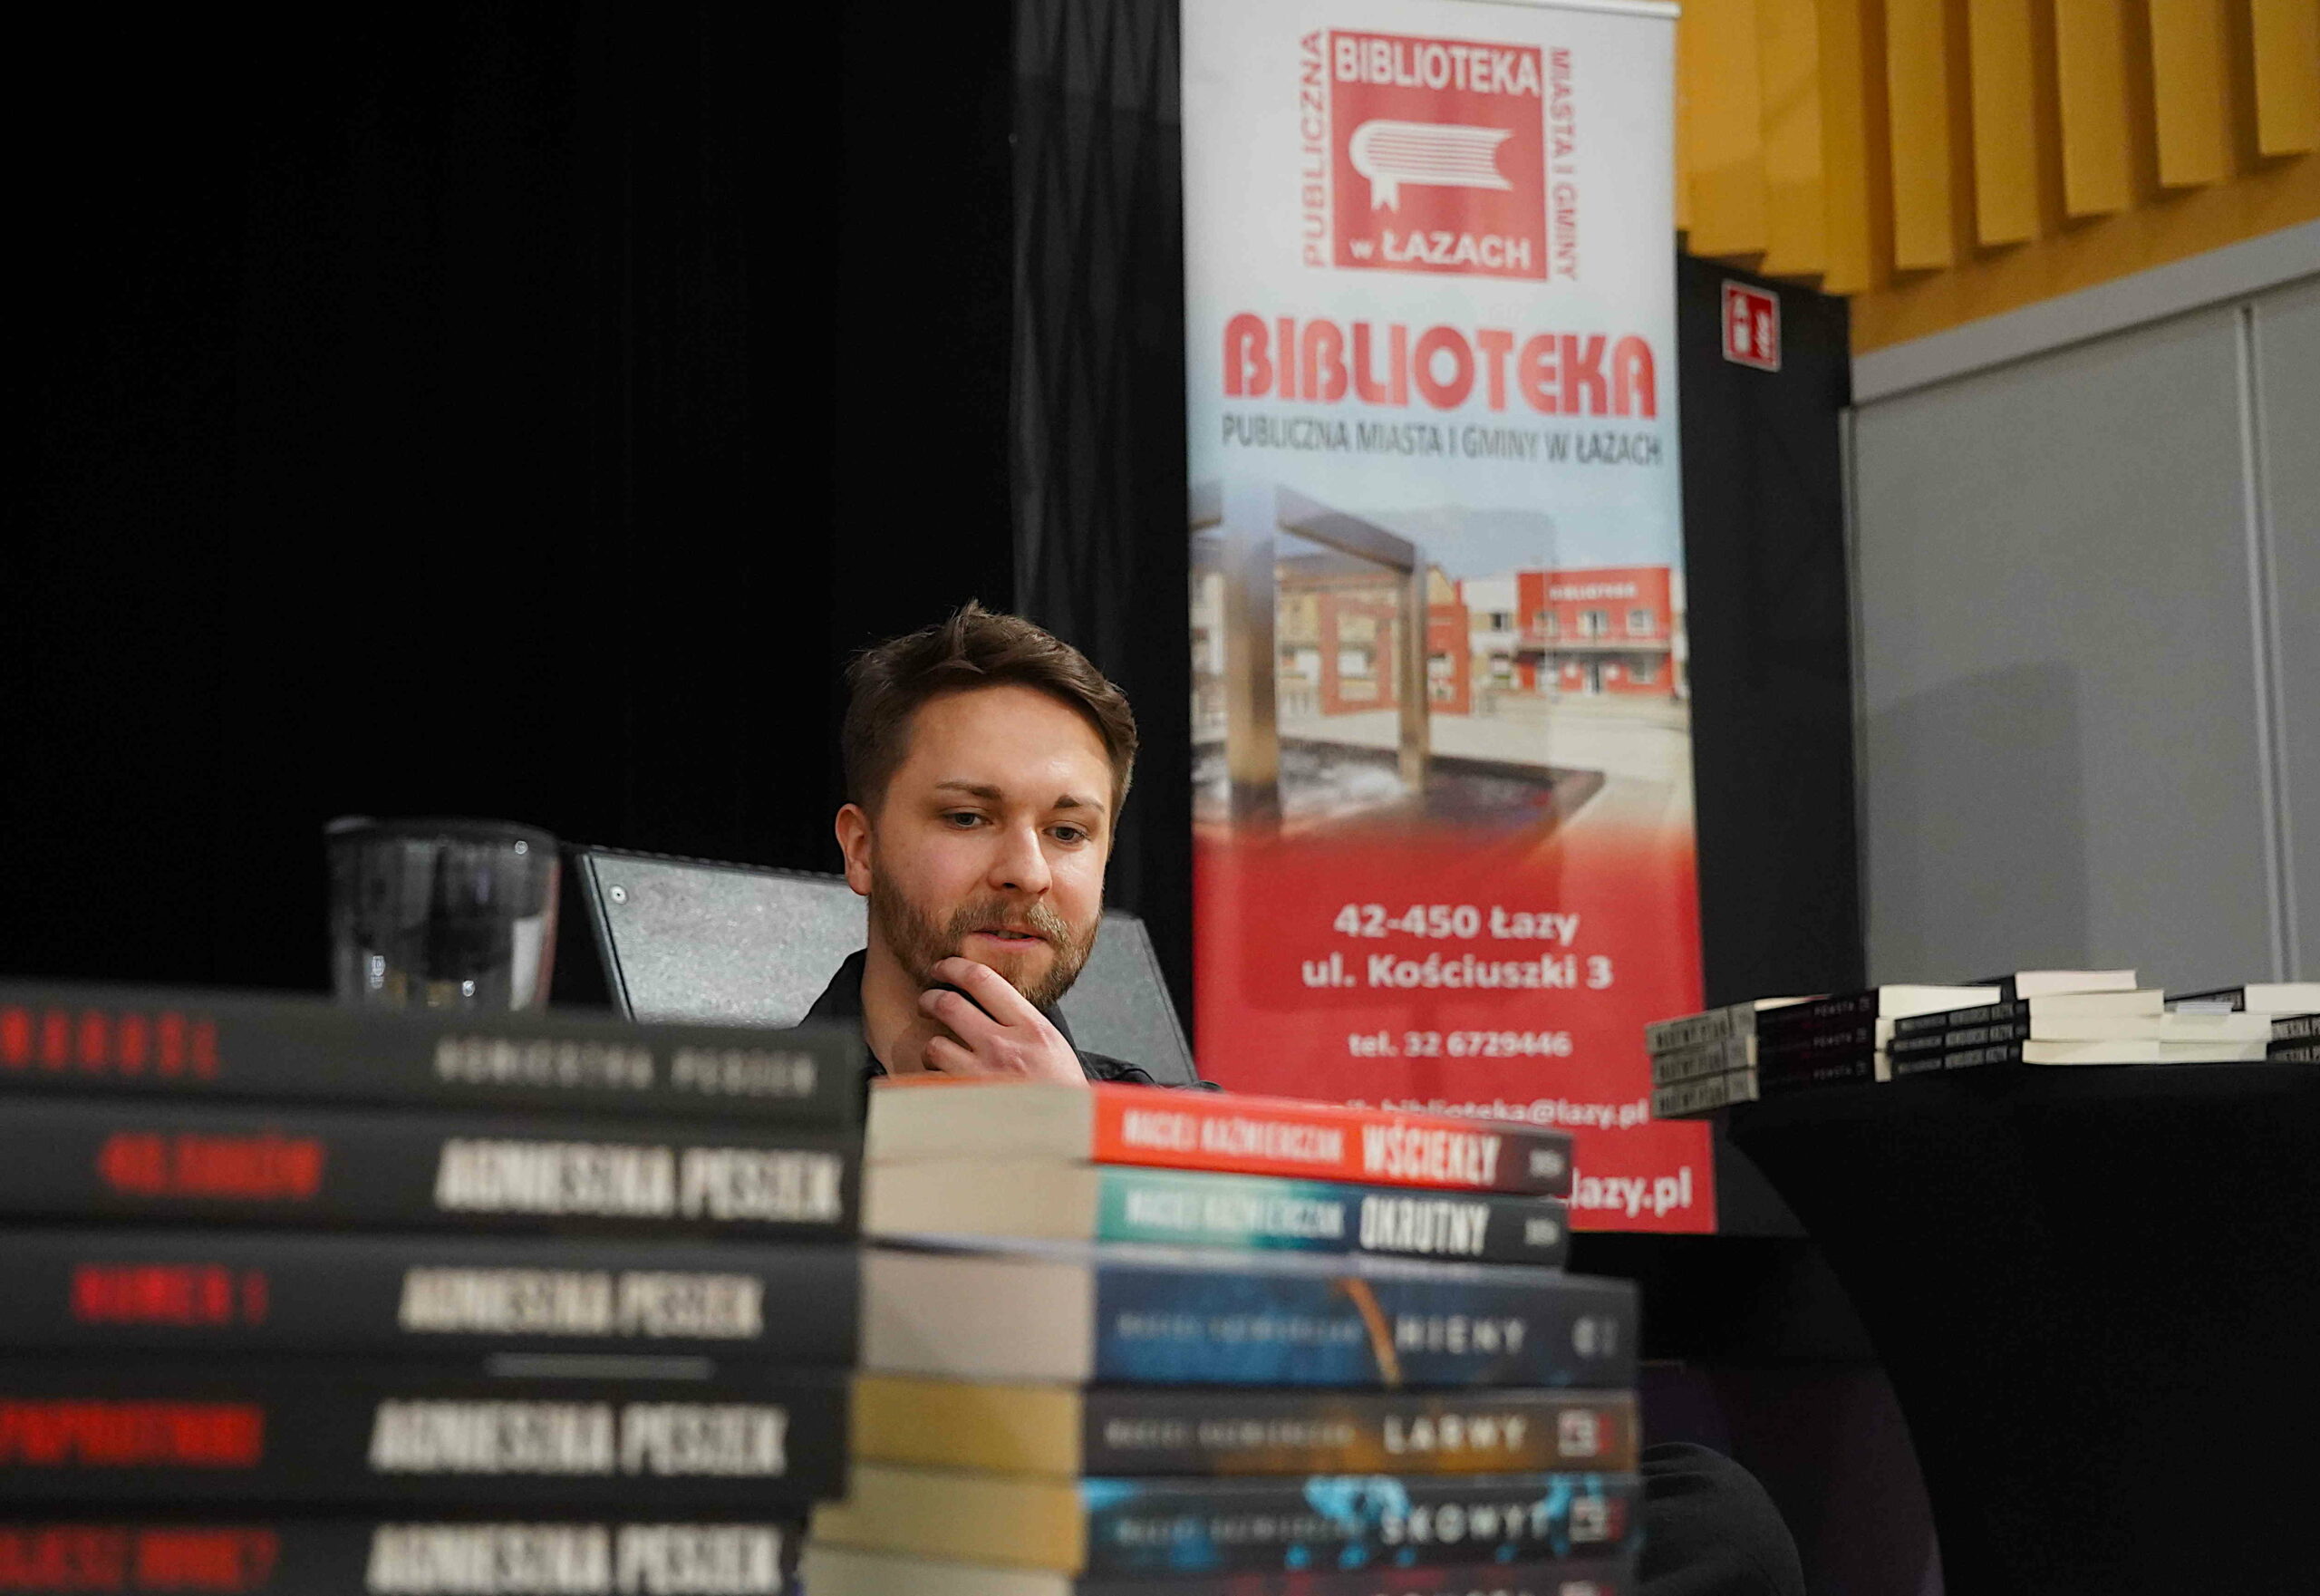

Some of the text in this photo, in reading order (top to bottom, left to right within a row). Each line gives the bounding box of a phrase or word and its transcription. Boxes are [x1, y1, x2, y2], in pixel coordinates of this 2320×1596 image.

[1334, 36, 1542, 97] BIBLIOTEKA
[1551, 46, 1575, 159] MIASTA
[1300, 29, 1326, 268] PUBLICZNA
[1381, 229, 1532, 270] ŁAZACH
[1552, 182, 1579, 282] GMINY
[1223, 312, 1658, 420] BIBLIOTEKA
[1222, 413, 1664, 467] PUBLICZNA MIASTA I GMINY W ŁAZACH
[1334, 904, 1580, 946] 42-450 Łazy
[1301, 952, 1614, 990] ul. Kościuszki 3
[1348, 1030, 1574, 1059] tel. 32 6729446
[1362, 1120, 1502, 1186] WŚCIEKŁY
[1571, 1166, 1692, 1217] lazy.pl
[1359, 1195, 1491, 1256] OKRUTNY
